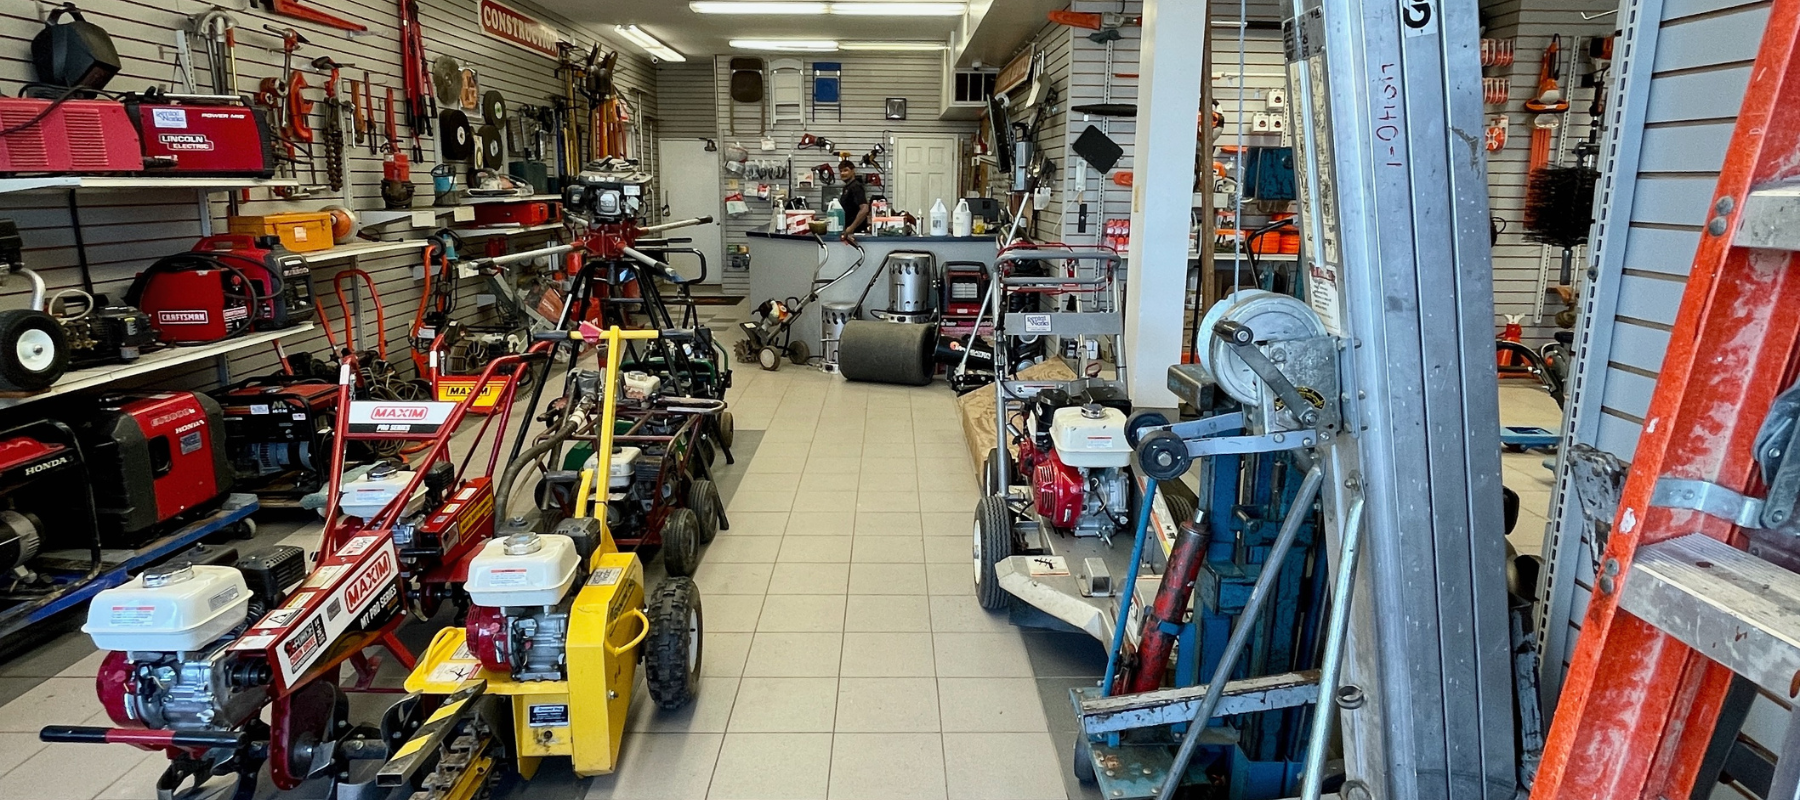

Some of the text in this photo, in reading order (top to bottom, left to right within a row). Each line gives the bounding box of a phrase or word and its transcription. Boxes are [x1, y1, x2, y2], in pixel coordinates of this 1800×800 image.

[483, 5, 558, 52] CONSTRUCTION
[162, 135, 204, 143] LINCOLN
[161, 313, 205, 321] CRAFTSMAN
[450, 387, 488, 395] MAXM
[374, 408, 424, 418] MAXIM
[175, 419, 205, 434] HONDA
[25, 456, 68, 475] HONDA
[347, 555, 389, 607] MAXIM
[370, 603, 382, 620] PRO
[379, 584, 398, 609] SERIES
